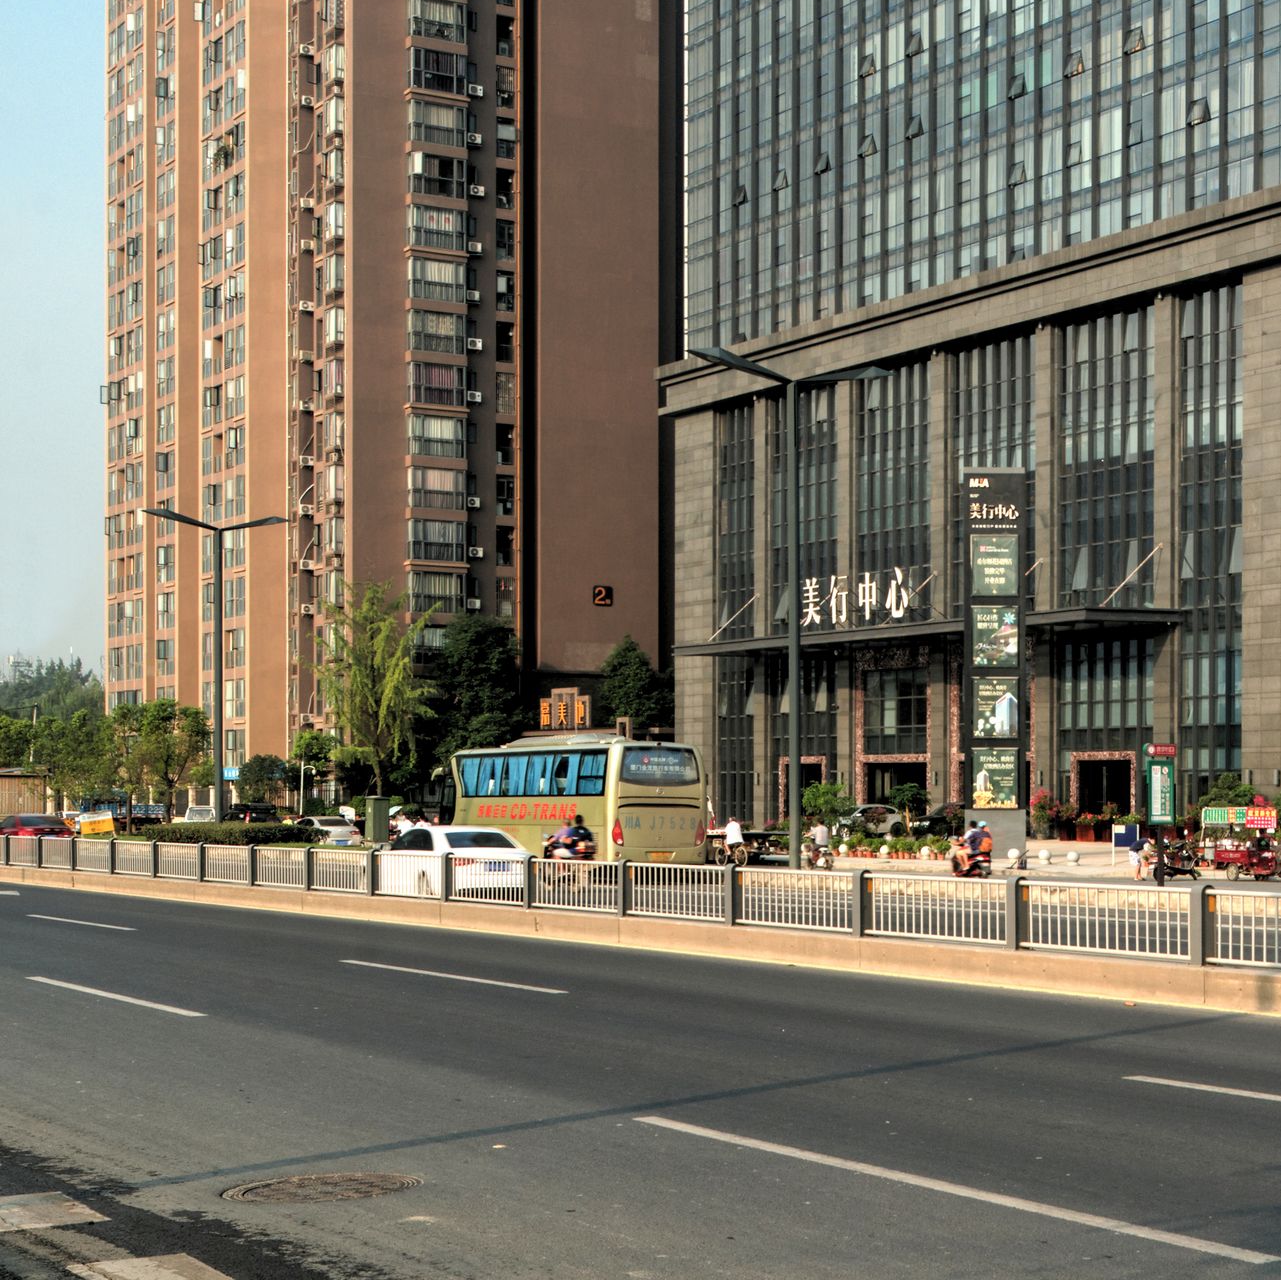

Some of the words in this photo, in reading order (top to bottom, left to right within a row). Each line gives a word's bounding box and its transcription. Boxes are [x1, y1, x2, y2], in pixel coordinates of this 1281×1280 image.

[969, 503, 1019, 520] 美行中心
[802, 566, 909, 626] 美行中心
[540, 699, 585, 726] 嘉美地
